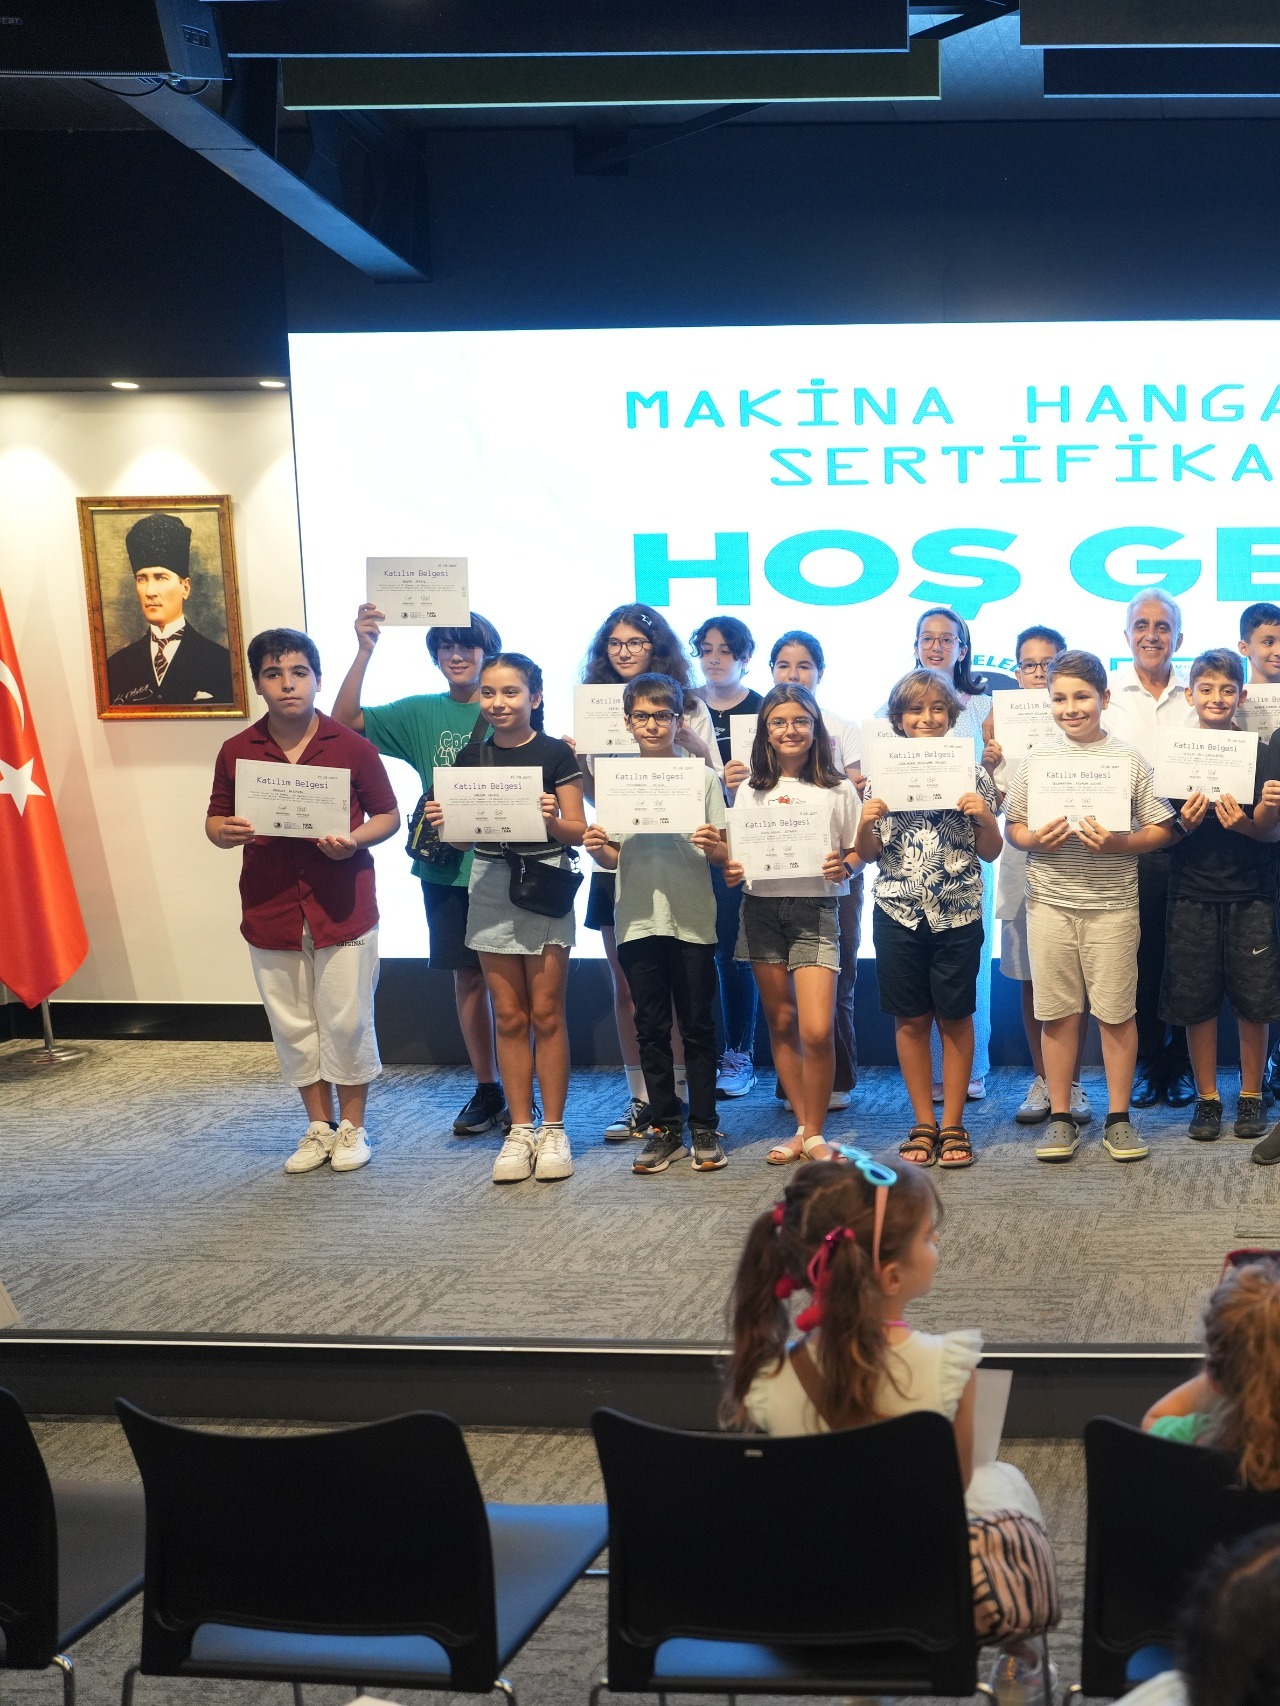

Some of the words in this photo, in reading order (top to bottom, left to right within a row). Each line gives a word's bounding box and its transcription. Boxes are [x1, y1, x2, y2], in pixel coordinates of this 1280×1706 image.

[626, 378, 953, 428] MAKİNA
[770, 434, 1273, 486] SERTİFİKA
[633, 528, 1021, 621] HOŞ
